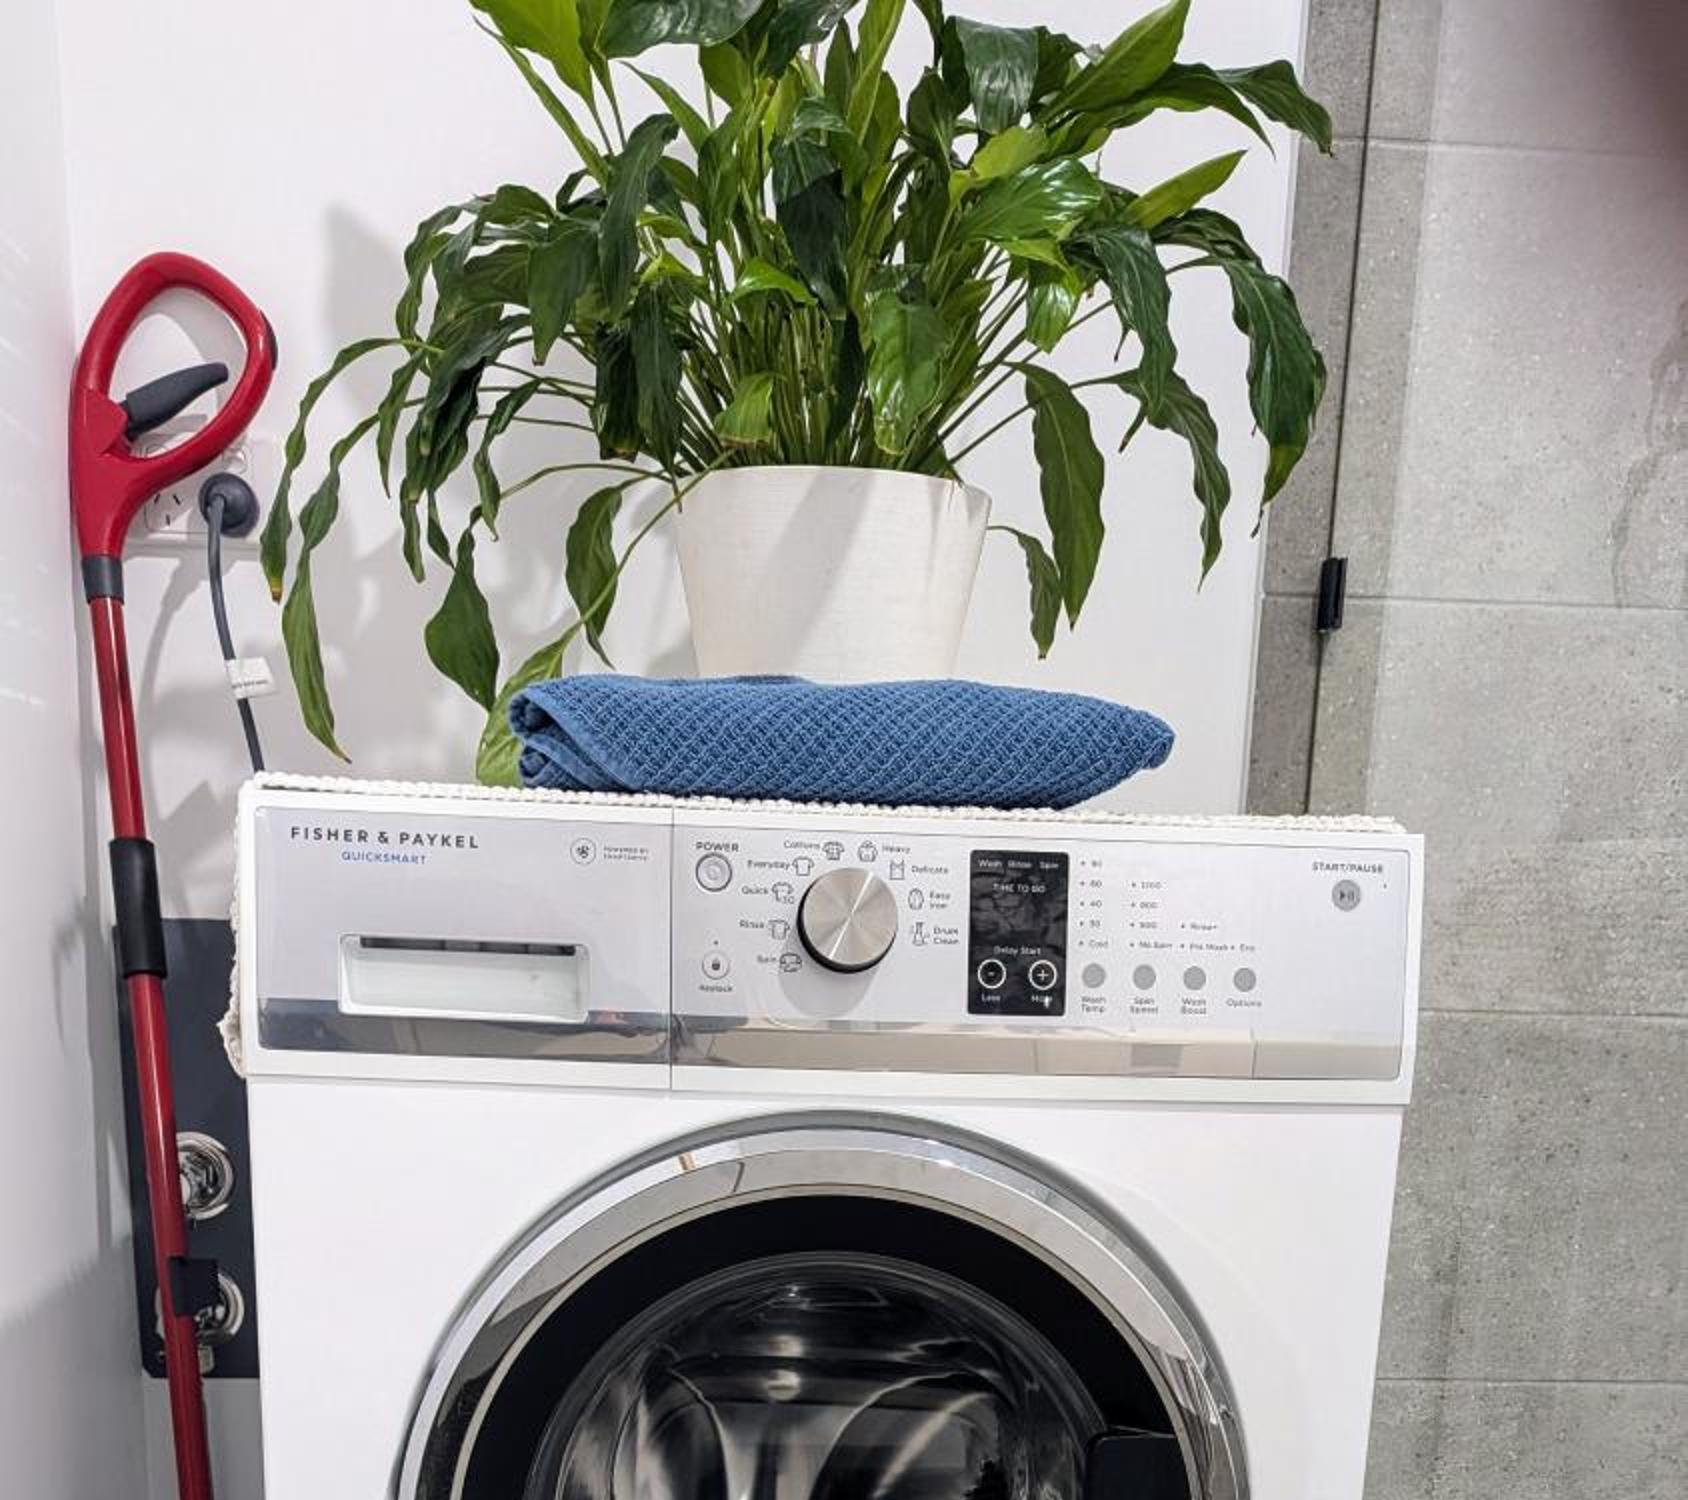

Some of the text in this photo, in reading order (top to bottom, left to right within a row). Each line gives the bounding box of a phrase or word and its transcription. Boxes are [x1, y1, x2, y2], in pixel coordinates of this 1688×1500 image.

[290, 826, 479, 849] FISHER & PAYKEL
[695, 841, 739, 852] POWER
[882, 845, 911, 855] Heavy
[341, 851, 426, 865] QUICKSMART
[747, 860, 790, 871] Everyday
[978, 859, 1003, 868] Wash
[1312, 861, 1383, 873] START/PAUSE
[911, 865, 949, 875] Delicate
[741, 885, 769, 895] Quick
[993, 883, 1046, 894] TIME TO GO
[739, 919, 765, 929] Rinse
[933, 926, 959, 935] Drum
[993, 945, 1041, 957] Delay Start
[1181, 997, 1207, 1006] Wash
[1225, 998, 1262, 1008] Options
[1081, 1004, 1105, 1014] Temp
